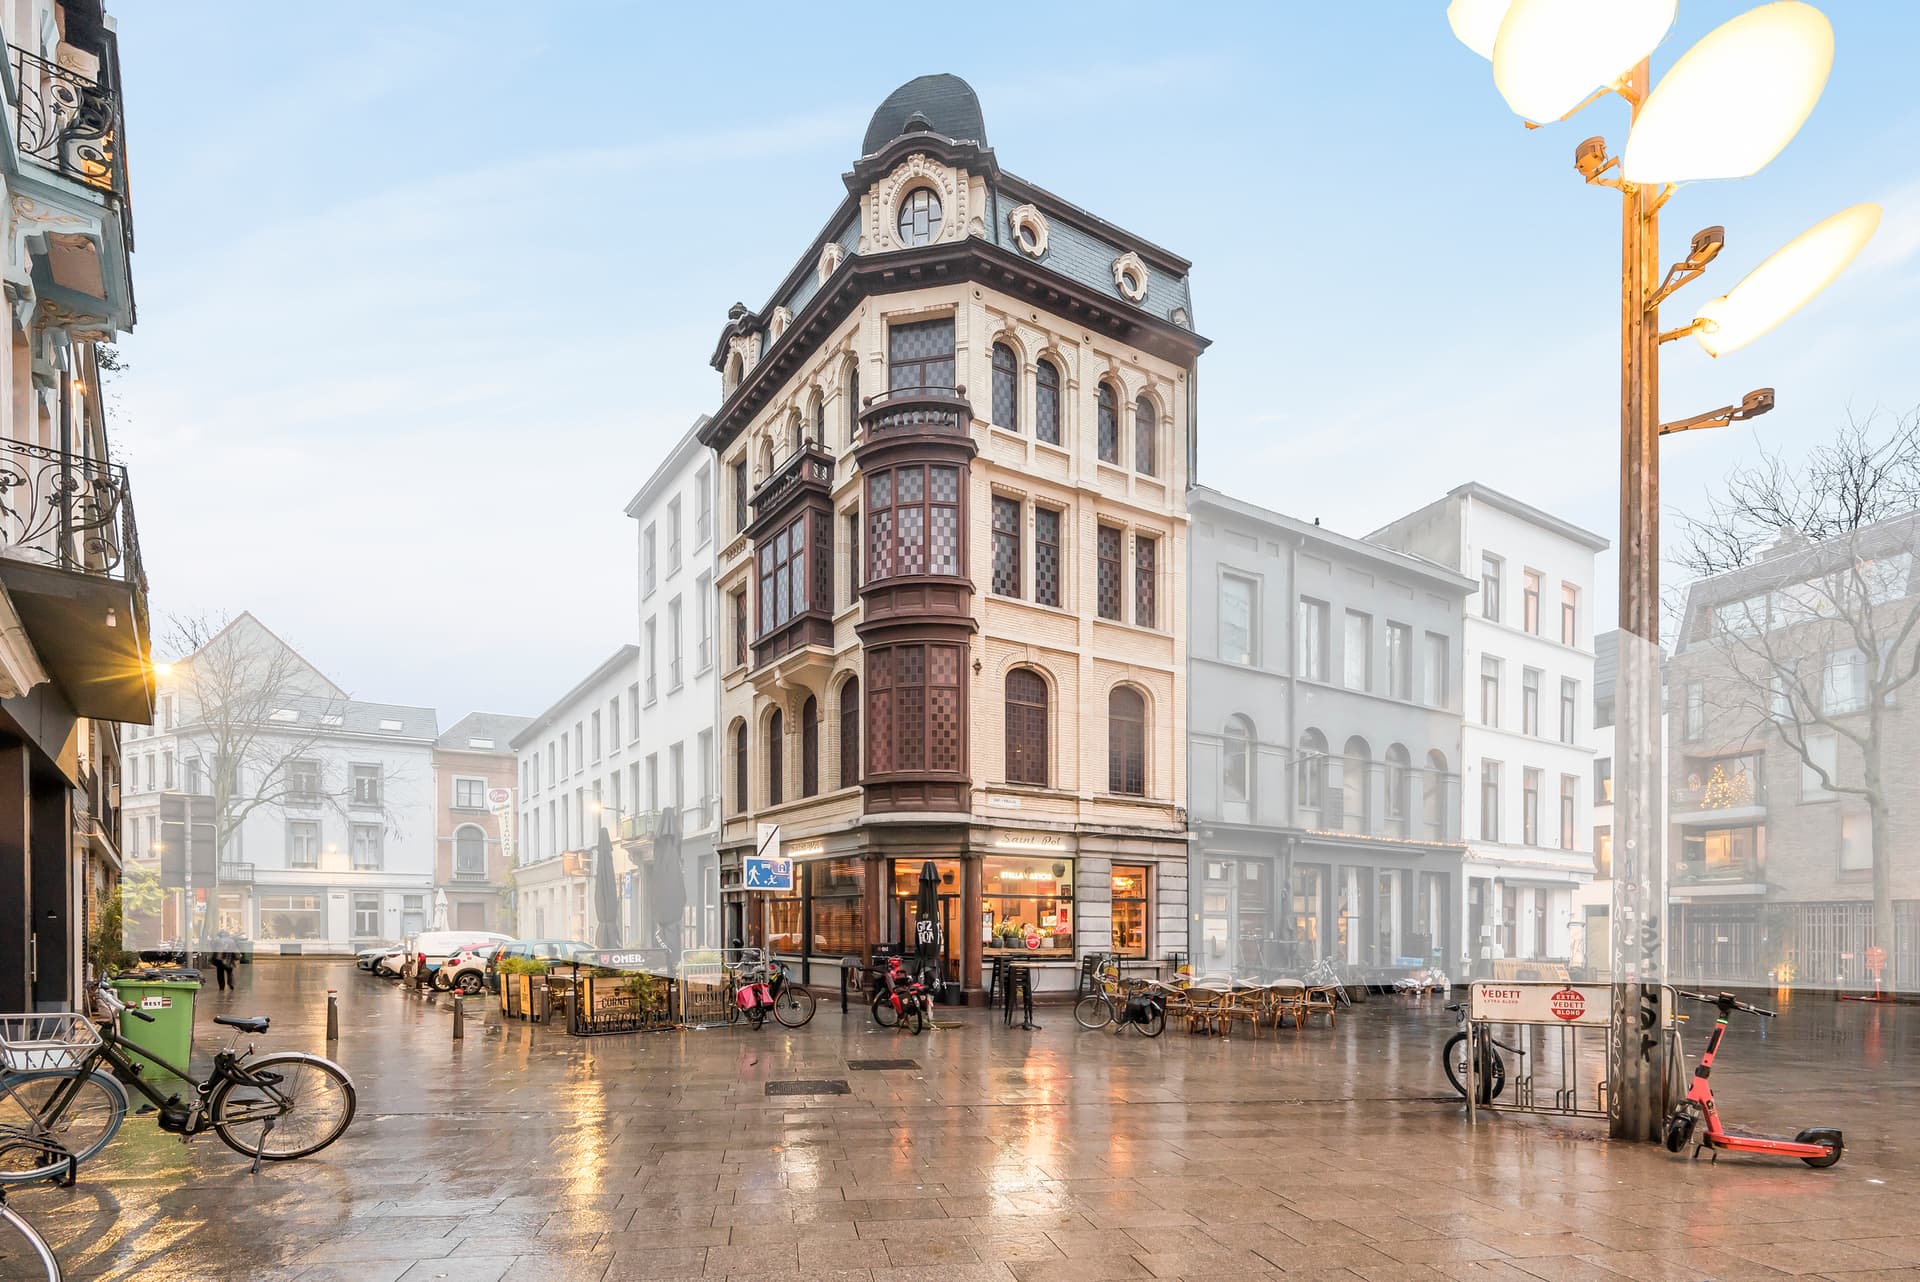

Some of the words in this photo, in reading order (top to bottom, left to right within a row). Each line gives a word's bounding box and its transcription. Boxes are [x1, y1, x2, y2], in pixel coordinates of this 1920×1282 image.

[1003, 832, 1035, 844] Saint
[1481, 990, 1521, 999] VEDETT
[1553, 1001, 1584, 1009] VEDETT
